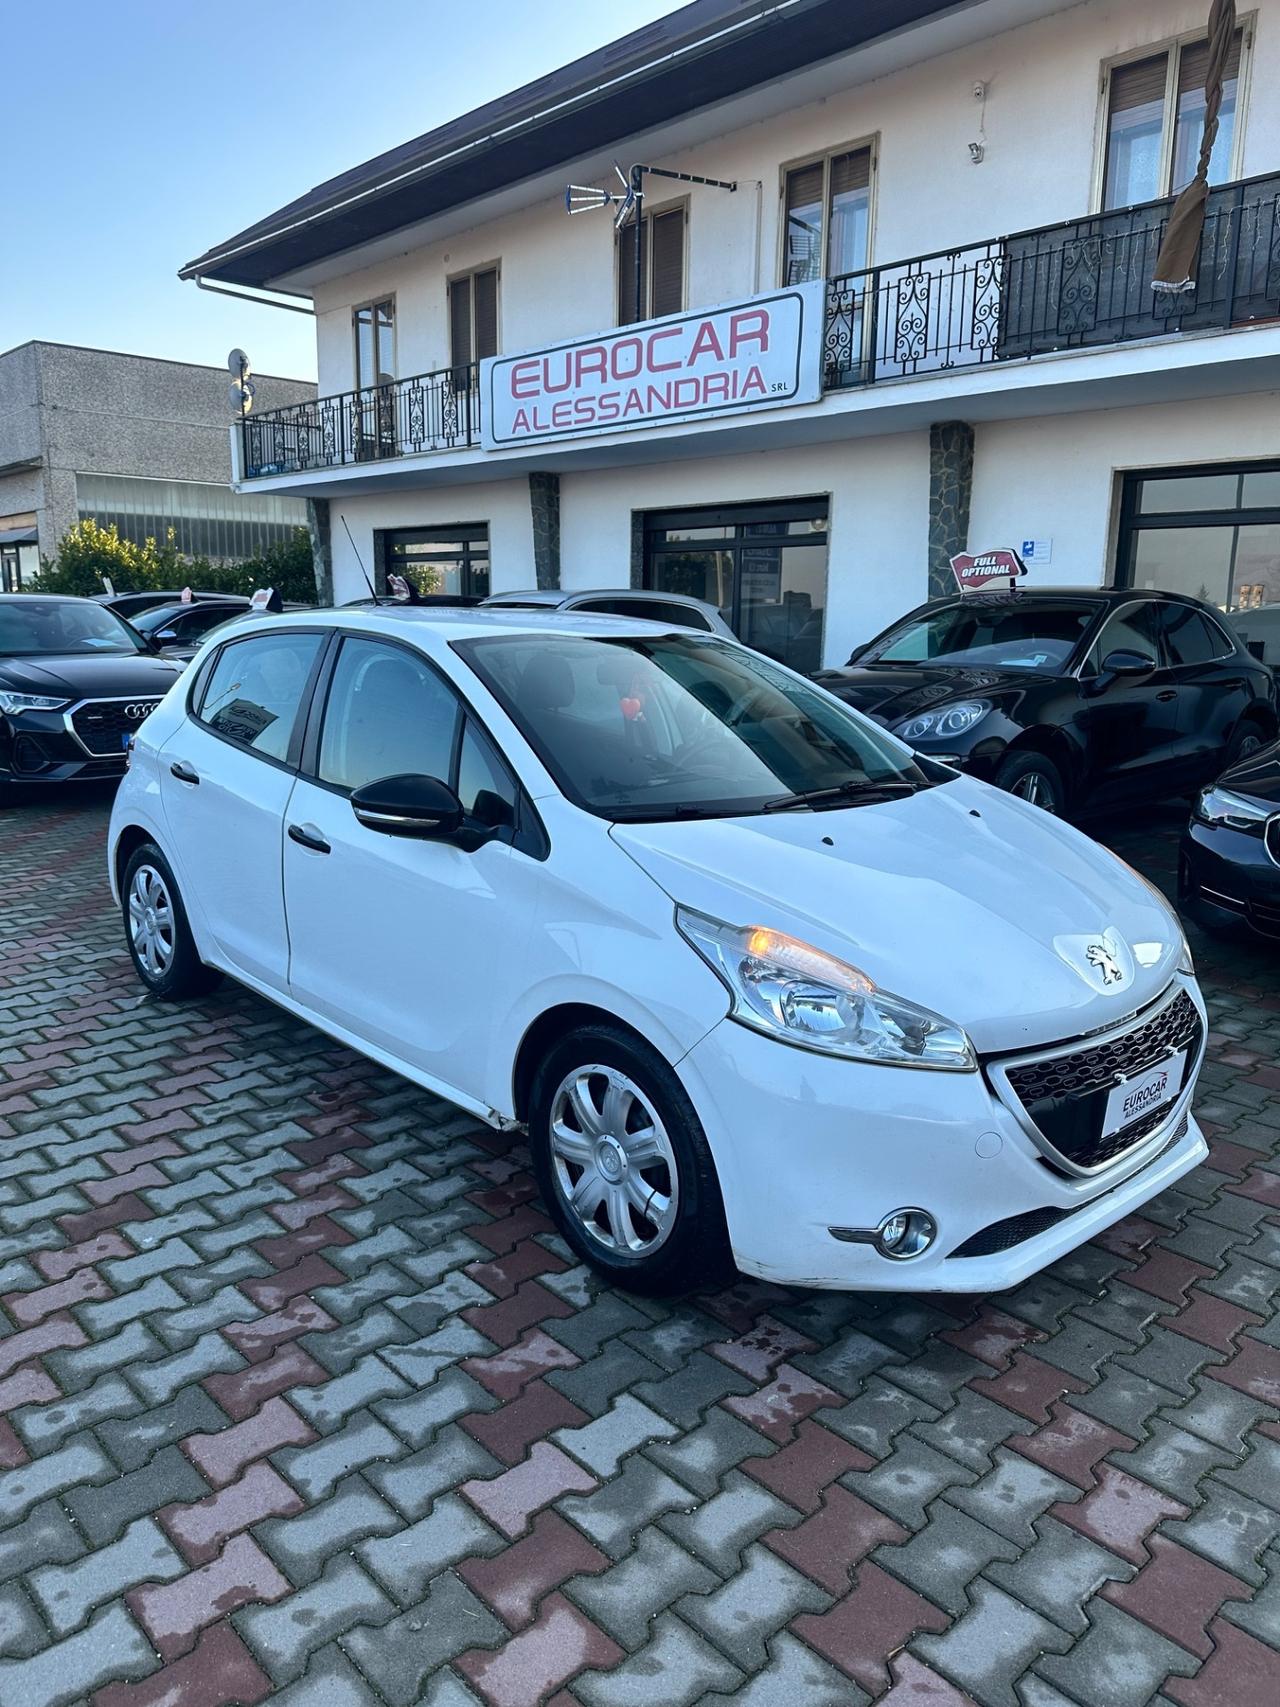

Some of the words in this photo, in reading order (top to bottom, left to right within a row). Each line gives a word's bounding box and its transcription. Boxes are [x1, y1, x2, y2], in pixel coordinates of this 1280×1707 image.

[511, 309, 769, 399] EUROCAR
[512, 366, 767, 434] ALESSANDRIA
[771, 382, 788, 392] SRL
[962, 565, 1010, 577] OPTIONAL
[974, 556, 996, 566] FULL
[1123, 1077, 1168, 1112] EUROCAR
[1124, 1092, 1162, 1119] ALESSANDRIA
